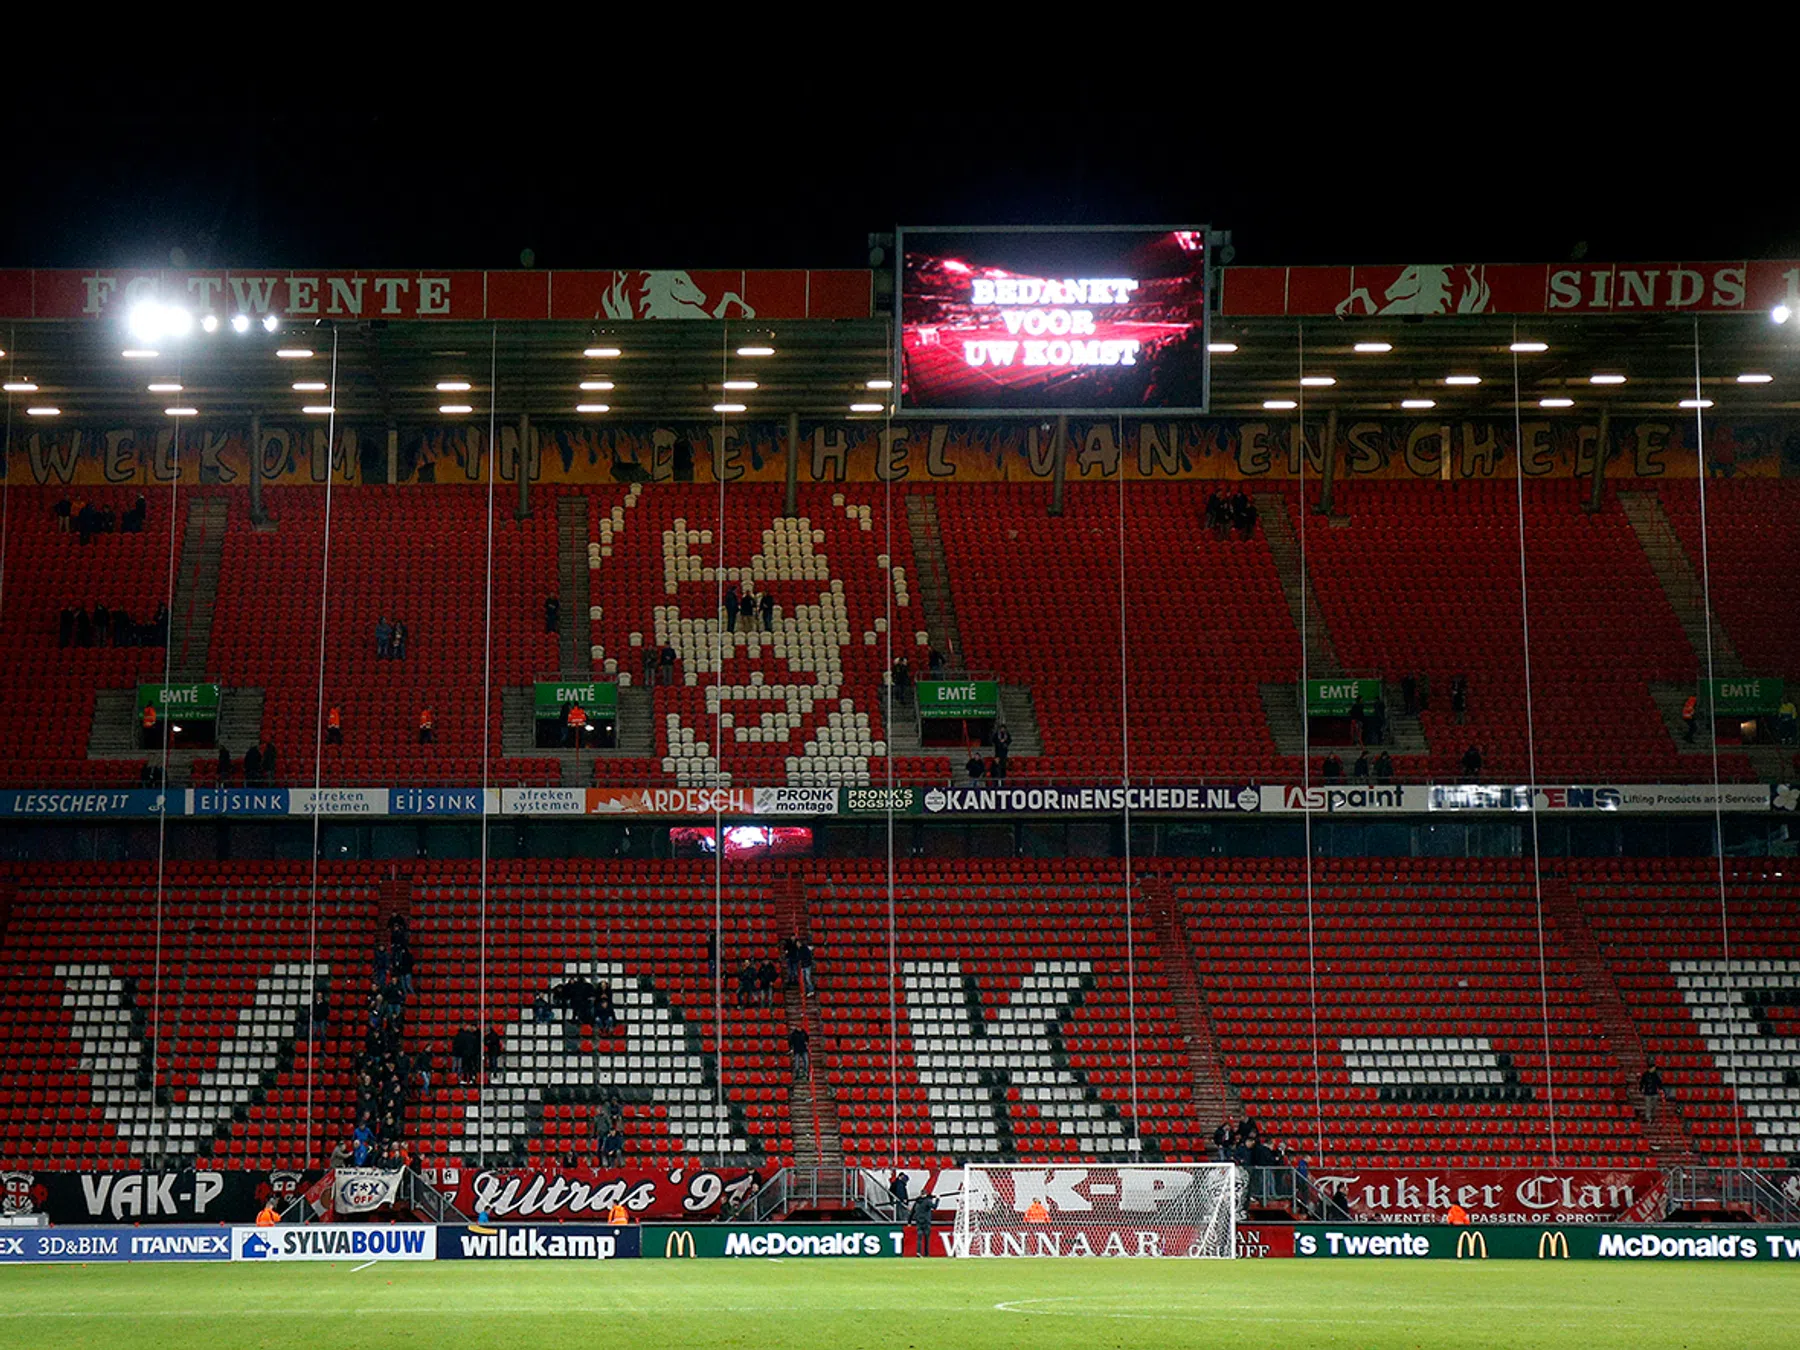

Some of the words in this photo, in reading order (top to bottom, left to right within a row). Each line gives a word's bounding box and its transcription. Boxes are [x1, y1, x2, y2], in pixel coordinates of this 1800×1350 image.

[188, 277, 451, 314] TWENTE
[972, 279, 1138, 304] BEDANKT
[1549, 267, 1746, 309] SINDS
[1000, 310, 1096, 336] VOOR
[963, 340, 1021, 366] UW
[1023, 340, 1140, 366] KOMST
[27, 427, 358, 484] WELKOM
[464, 423, 542, 481] IN
[650, 424, 746, 482] DE
[810, 424, 957, 481] HEL
[1027, 422, 1181, 476] VAN
[1238, 421, 1672, 477] ENSCHEDE
[160, 686, 198, 703] EMTÉ
[556, 685, 595, 701] EMTÉ
[938, 683, 976, 700] EMTÉ
[1320, 682, 1359, 699] EMTÉ
[14, 795, 107, 812] LESSCHER
[111, 795, 129, 809] IT
[309, 790, 364, 801] afreken
[519, 790, 573, 800] afreken
[639, 789, 744, 812] ARDESCH
[777, 789, 833, 800] PRONK
[848, 789, 913, 799] PRONK'S
[848, 799, 913, 808] DOGSHOP
[1657, 794, 1699, 804] Products
[304, 802, 370, 813] systemen
[513, 801, 579, 812] systemen
[776, 801, 833, 812] montage
[82, 1173, 224, 1220] VAK-P
[474, 1171, 656, 1215] Ultras
[1314, 1175, 1503, 1209] Tukker
[1516, 1176, 1635, 1209] Clan
[1441, 1213, 1526, 1223] APASSEN
[1532, 1213, 1550, 1222] OF
[38, 1236, 119, 1254] 3D&BIM
[132, 1236, 229, 1253] ITANNEX
[284, 1231, 425, 1255] SYLVABOUW
[461, 1228, 615, 1259] wildkamp
[725, 1233, 881, 1255] McDonald's
[939, 1231, 1164, 1257] WINNAAR
[1326, 1232, 1430, 1256] Twente
[1599, 1234, 1757, 1258] McDonald's
